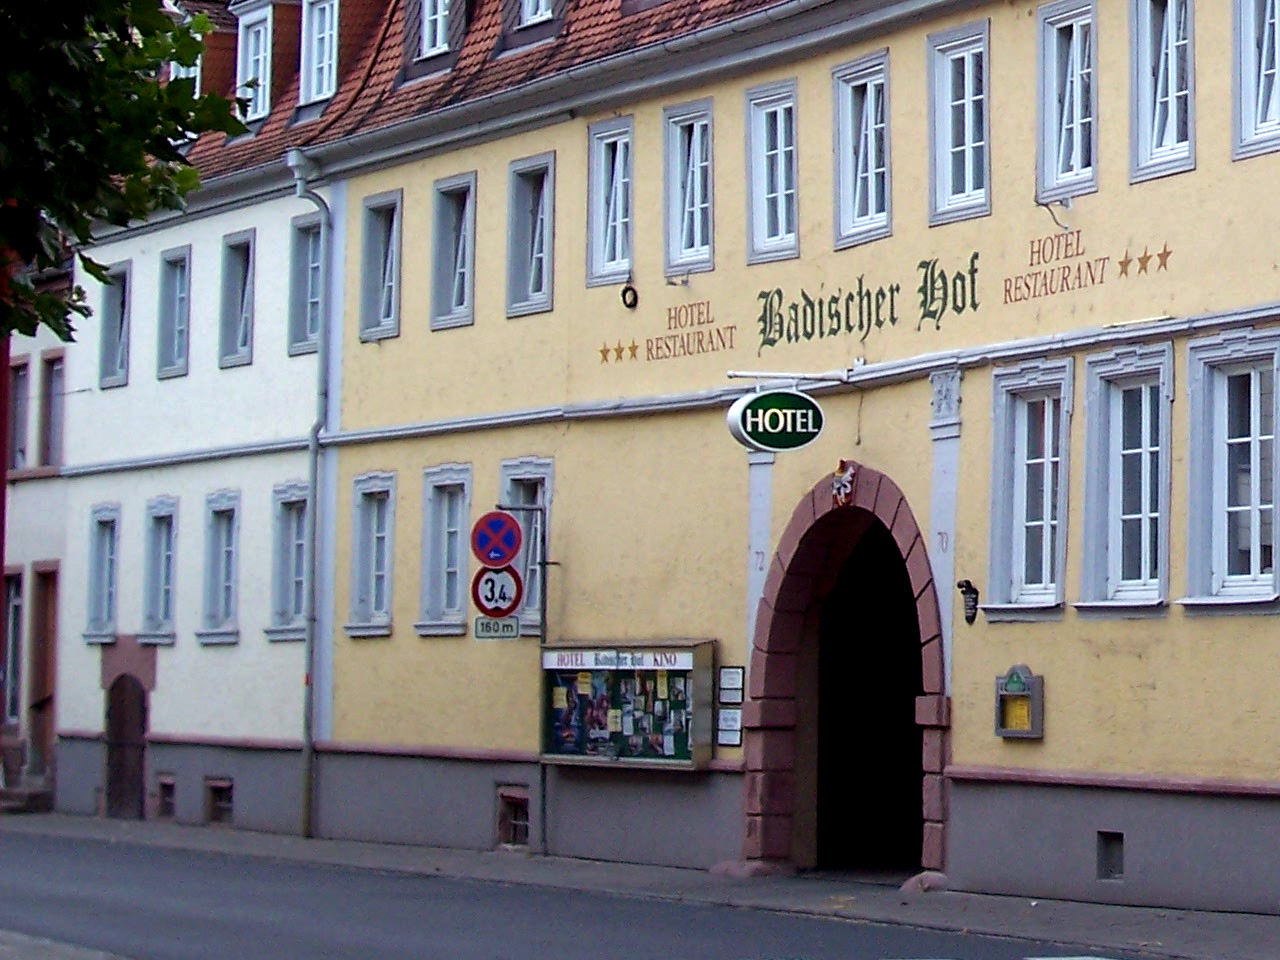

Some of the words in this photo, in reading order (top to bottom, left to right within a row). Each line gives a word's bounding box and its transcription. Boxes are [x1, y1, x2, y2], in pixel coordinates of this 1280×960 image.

[1029, 230, 1086, 267] HOTEL
[1004, 257, 1111, 305] RESTAURANT
[667, 301, 715, 331] HOTEL
[756, 274, 902, 358] Badischer
[916, 251, 982, 332] Hof
[645, 326, 738, 362] RESTAURANT
[745, 407, 819, 435] HOTEL
[480, 621, 500, 633] 160
[502, 623, 514, 633] m
[556, 652, 586, 667] HOTEL
[652, 652, 677, 667] KINO
